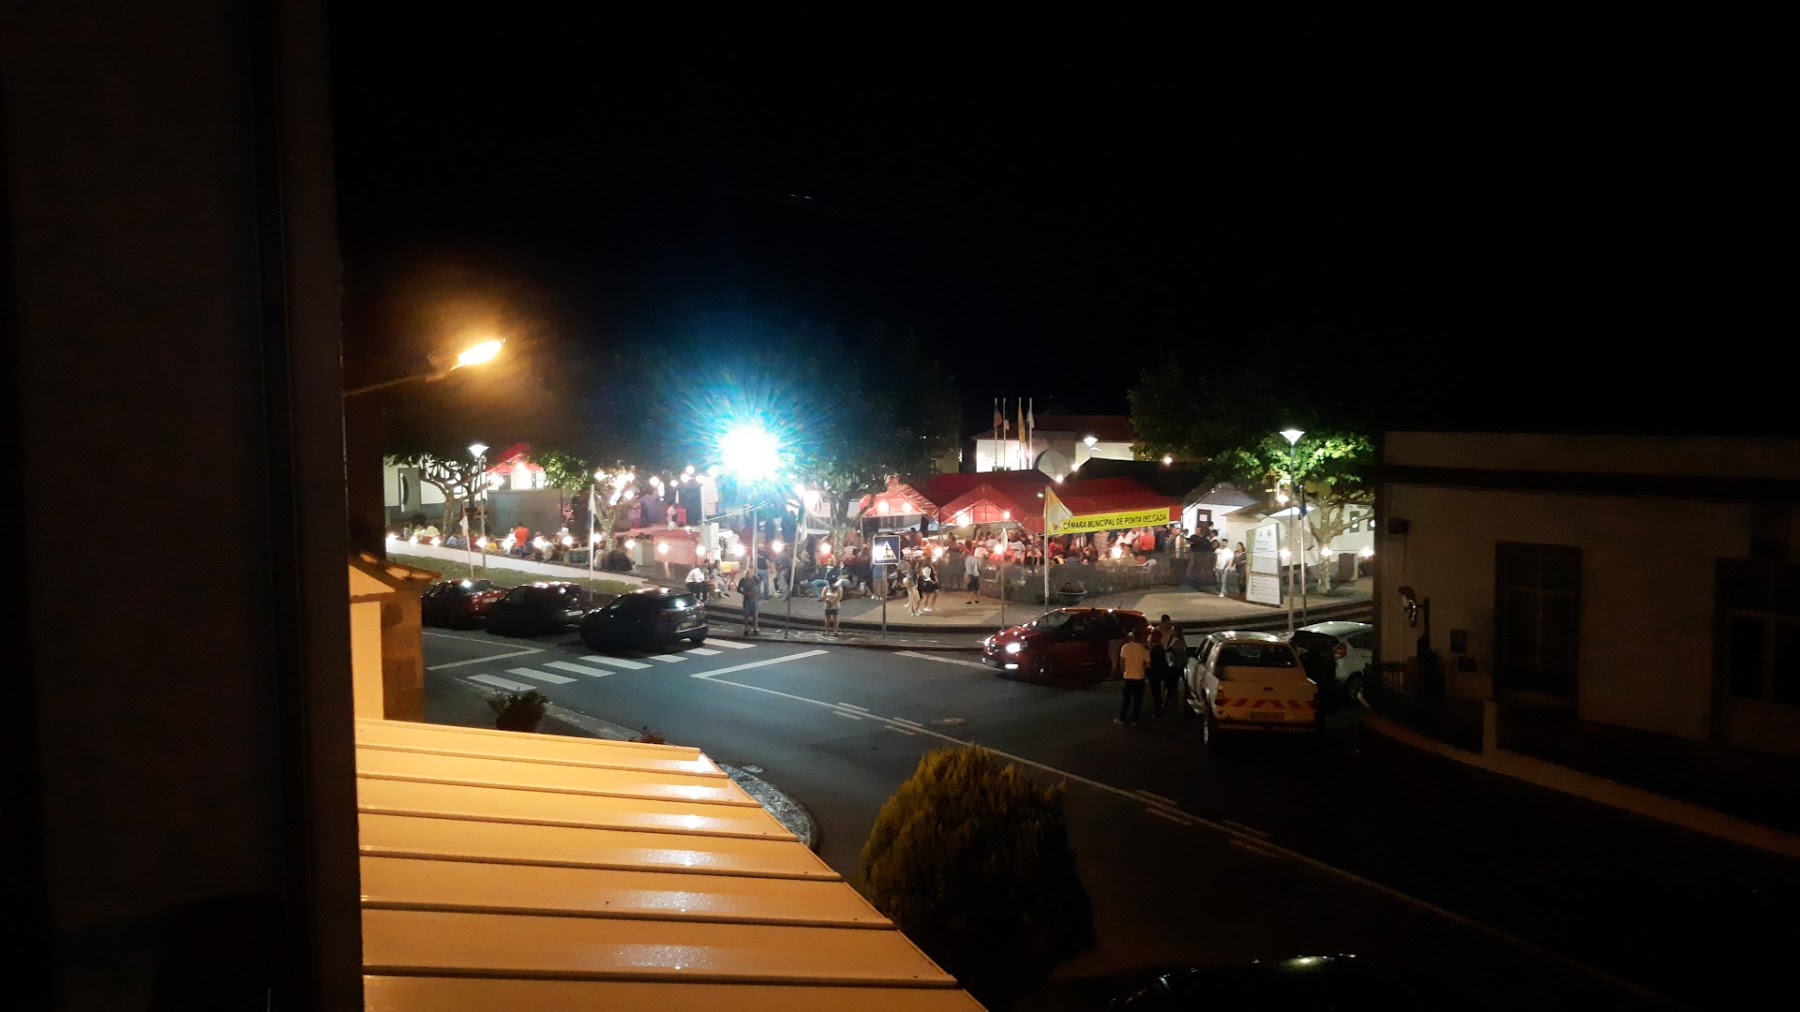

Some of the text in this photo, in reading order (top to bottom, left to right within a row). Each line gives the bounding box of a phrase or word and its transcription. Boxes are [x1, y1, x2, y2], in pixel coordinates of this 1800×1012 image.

[1063, 513, 1167, 530] CÂMARA MUNICIPAL DE PONTA DELGADA
